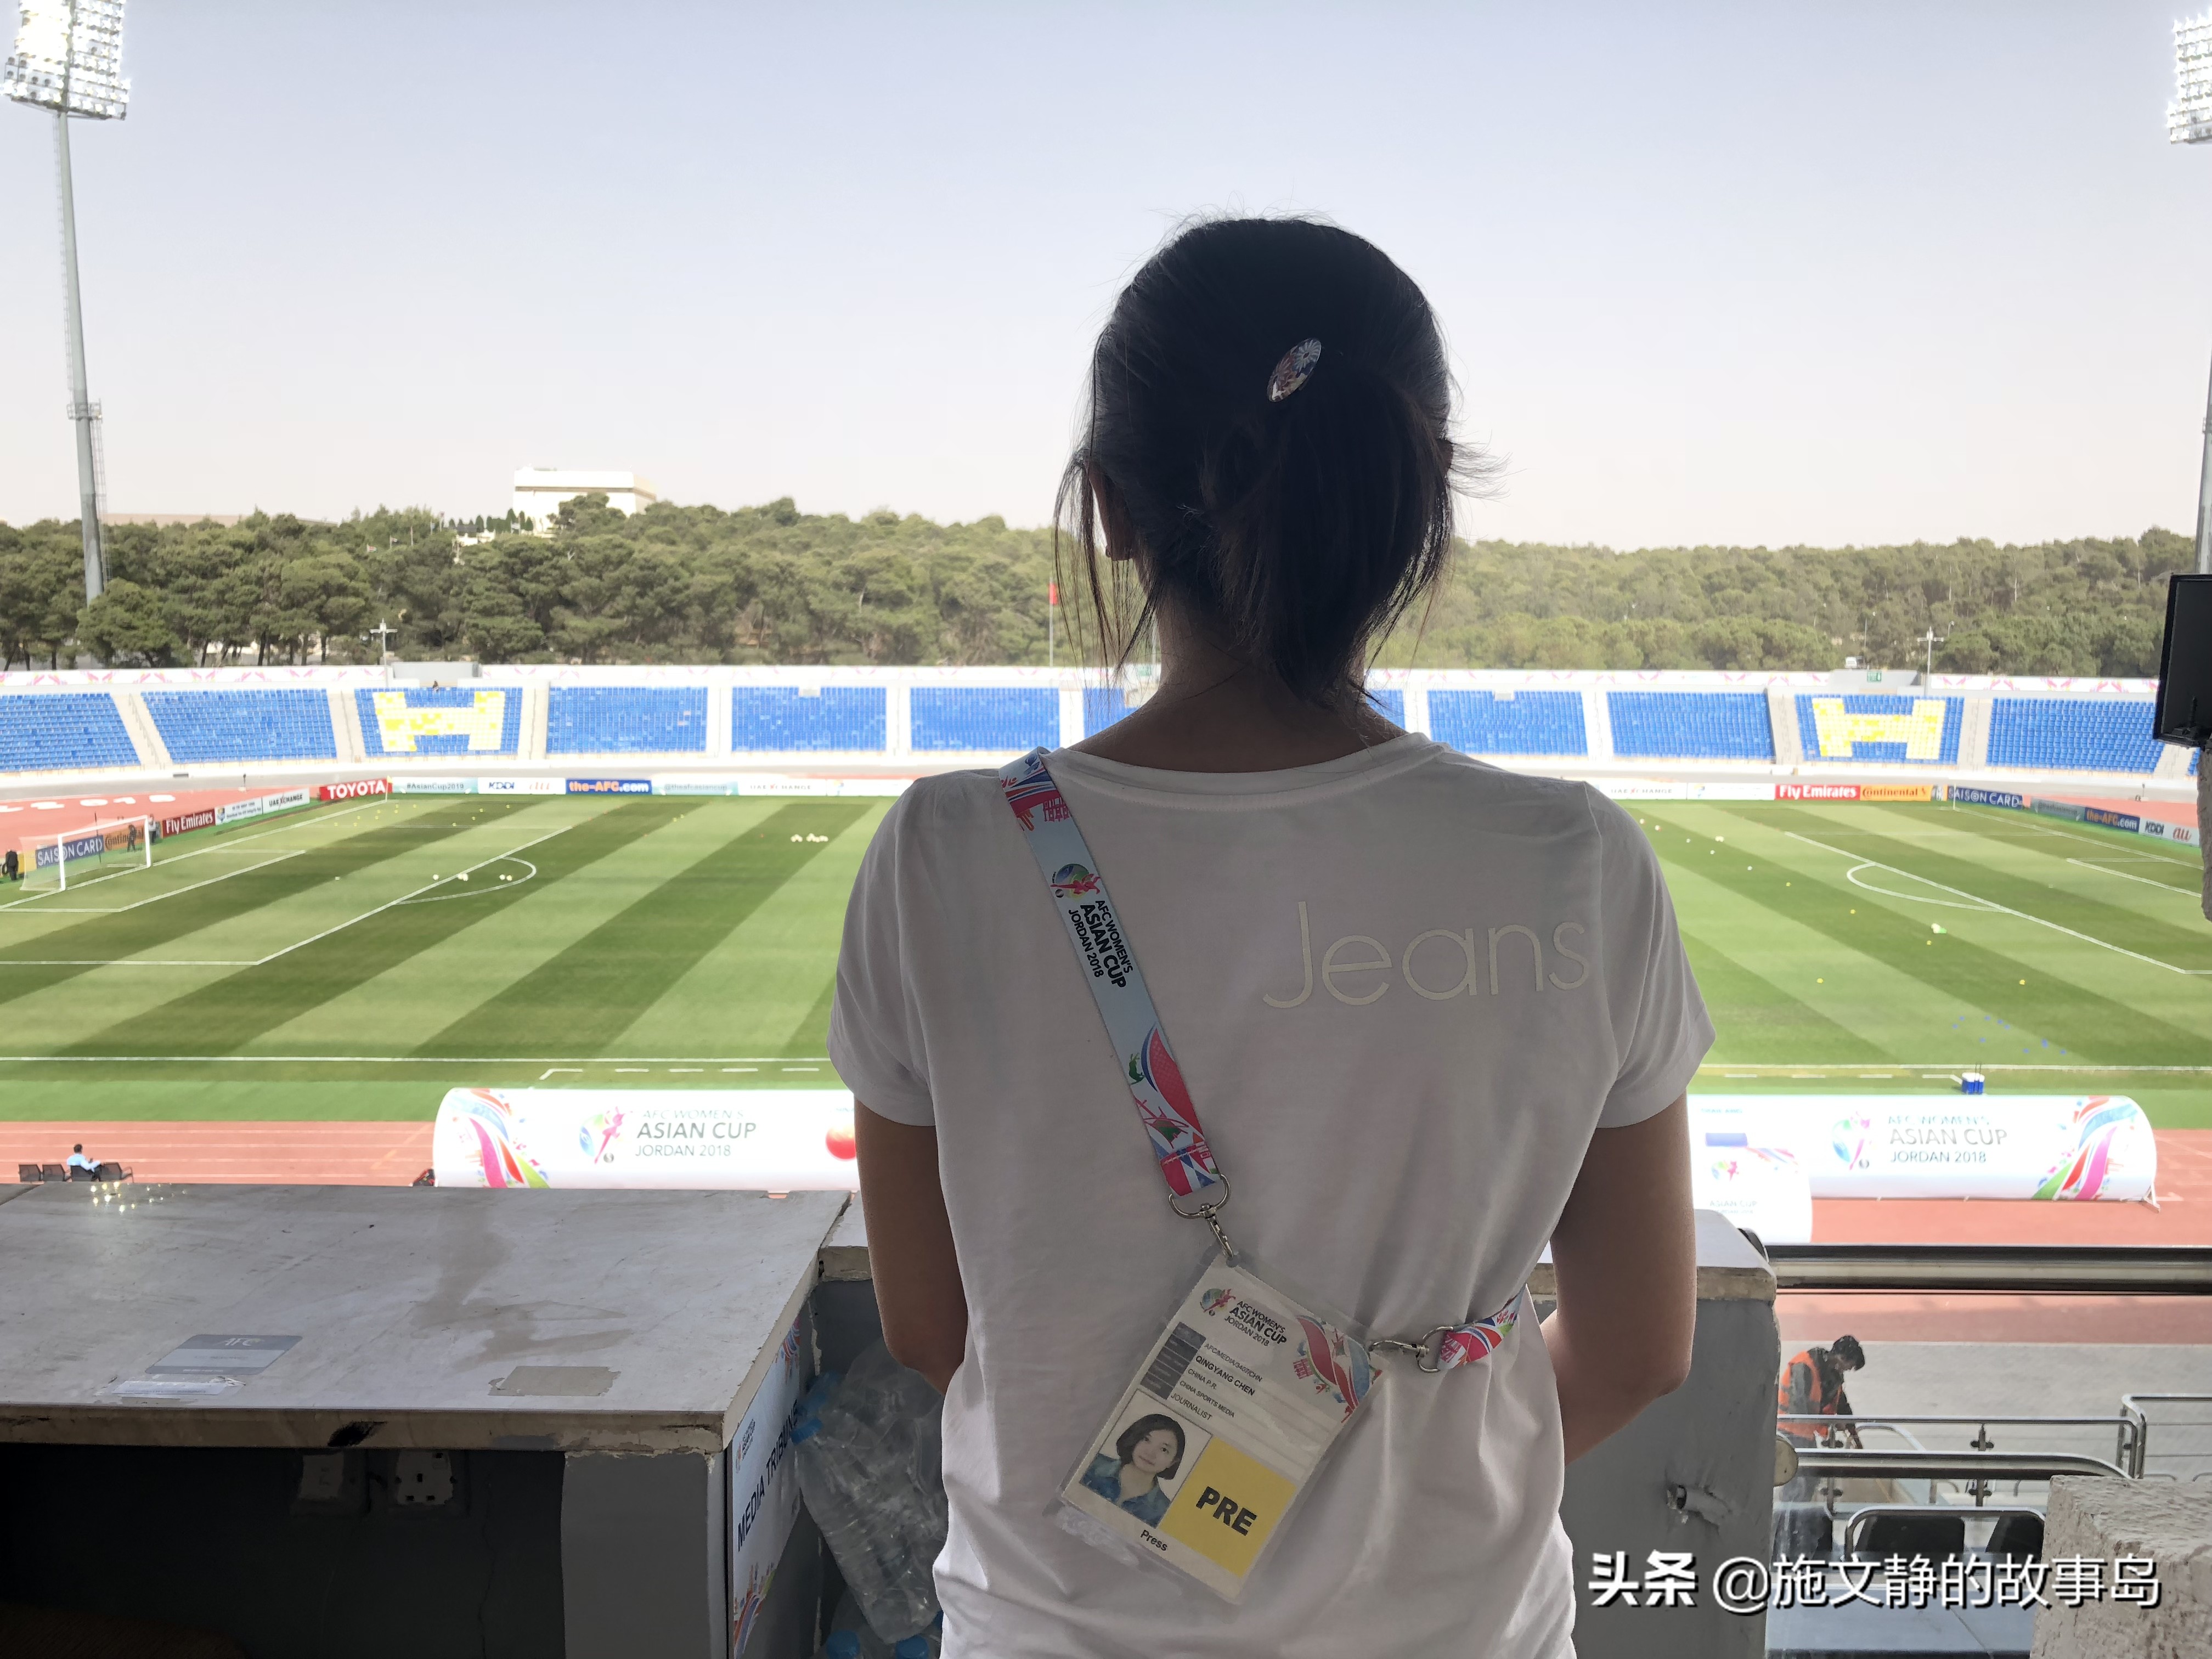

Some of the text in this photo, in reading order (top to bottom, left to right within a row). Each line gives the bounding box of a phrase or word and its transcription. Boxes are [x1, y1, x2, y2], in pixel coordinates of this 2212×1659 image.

[327, 780, 386, 800] TOYOTA
[569, 781, 649, 792] the-AFC.com
[1779, 785, 1856, 800] Fly Emirates
[1862, 785, 1918, 798] Continental
[1948, 787, 2019, 808] SAISON CARD
[166, 819, 180, 834] Fly
[181, 812, 213, 830] Emirates
[2086, 809, 2137, 831] the-AFC.com
[2145, 821, 2164, 836] KDDI
[76, 838, 103, 858] CARD
[1068, 909, 1104, 978] JORDAN 2018
[1080, 904, 1126, 988] ASIAN CUP
[1095, 900, 1133, 973] AFC WOMEN'S
[1263, 901, 1590, 1008] Jeans
[642, 1110, 670, 1119] AFC
[636, 1122, 757, 1139] ASIAN CUP
[1889, 1128, 2007, 1145] ASIAN CUP
[635, 1144, 731, 1156] JORDAN 2018
[1891, 1150, 1987, 1163] JORDAN 2018
[1229, 1307, 1287, 1344] ASIAN CUP
[1237, 1301, 1285, 1334] AFC WOMEN'S
[1224, 1316, 1269, 1346] JORDAN 2018
[1188, 1368, 1206, 1383] CHINA
[1195, 1356, 1234, 1383] QINGYANG
[1234, 1380, 1255, 1396] CHEN
[1171, 1393, 1213, 1420] JOURNALIST
[1180, 1380, 1235, 1418] CHINA SPORTS MEDIA
[737, 1475, 765, 1551] MEDIA
[766, 1400, 798, 1486] TRIBUNE
[1195, 1486, 1257, 1536] PRE
[1140, 1529, 1168, 1552] Press
